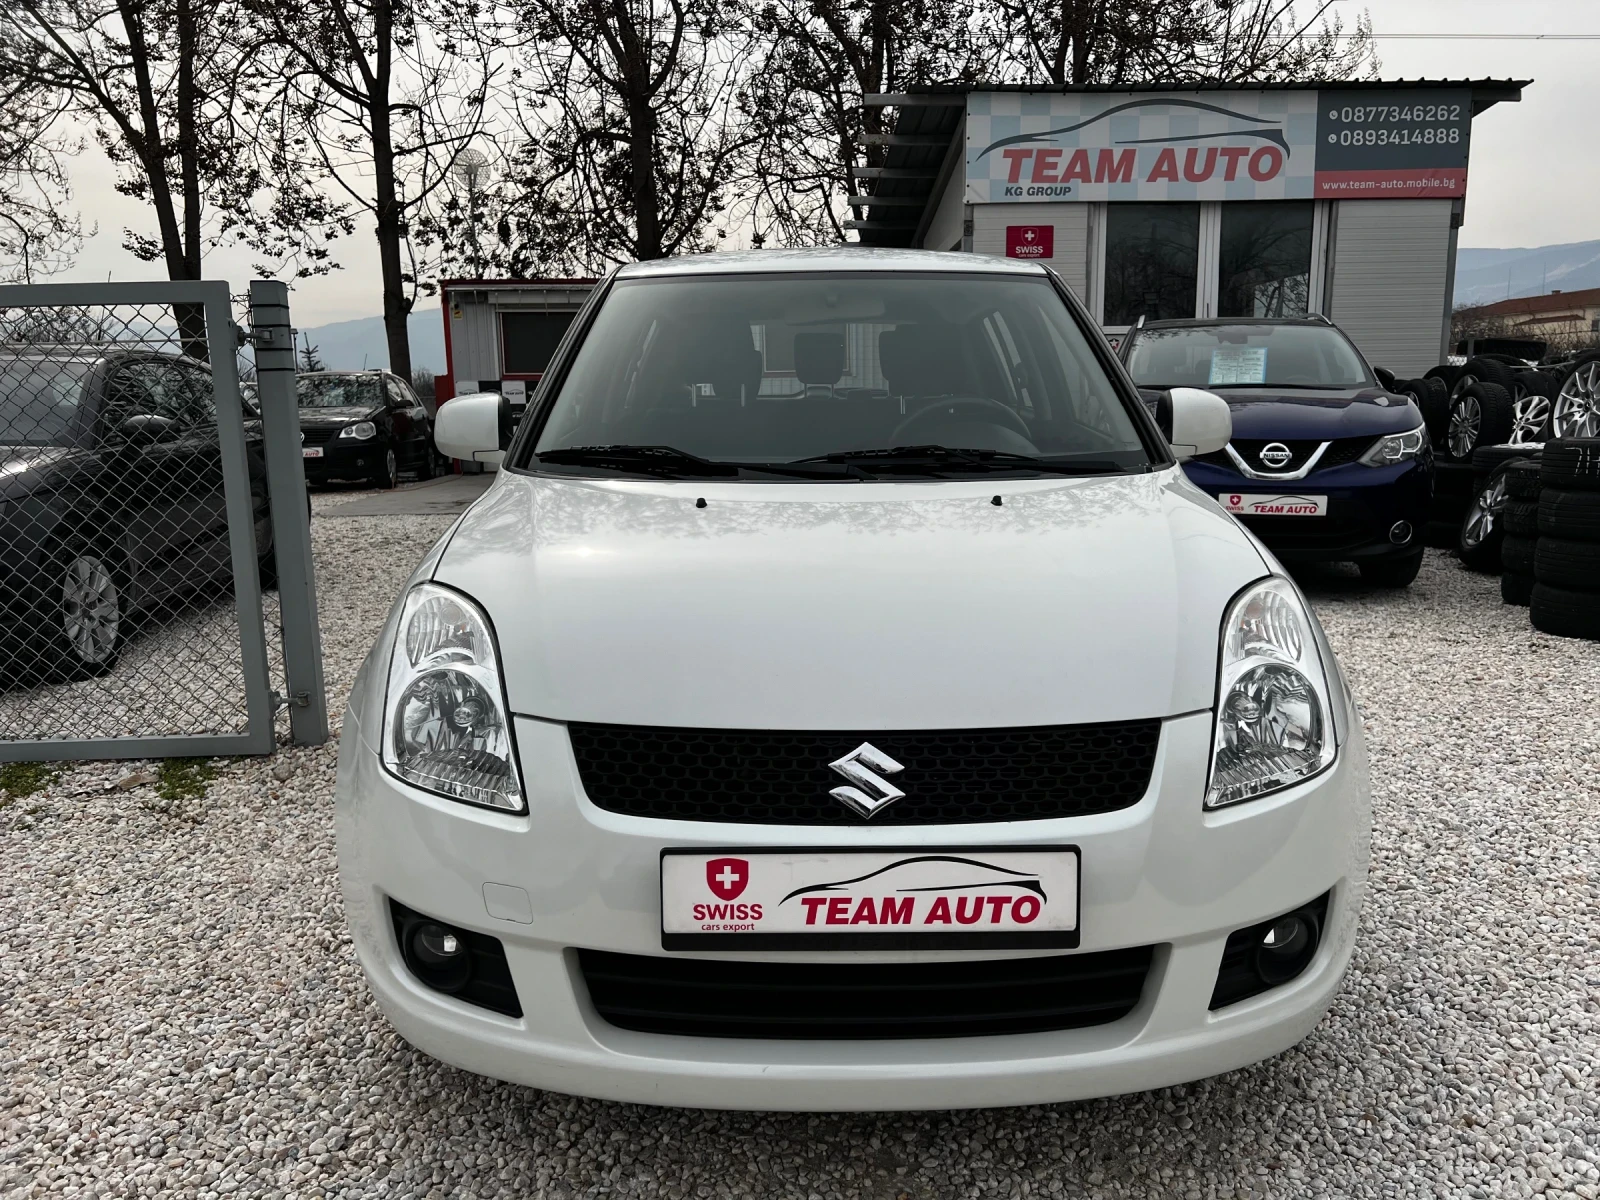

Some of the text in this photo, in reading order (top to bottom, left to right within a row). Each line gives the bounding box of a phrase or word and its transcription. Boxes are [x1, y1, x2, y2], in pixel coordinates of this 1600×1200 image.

[1341, 105, 1461, 123] 0877346262
[1340, 128, 1460, 146] 0893414888
[1002, 145, 1283, 184] TEAM AUTO
[1322, 177, 1456, 190] www.team-auto.mobile.bg
[1004, 186, 1072, 197] KG GROUP
[1015, 245, 1044, 255] SWISS
[1254, 505, 1318, 514] TEAM AUTO
[693, 903, 763, 921] SWISS
[801, 895, 1041, 925] TEAM AUTO
[701, 923, 755, 933] cars export
